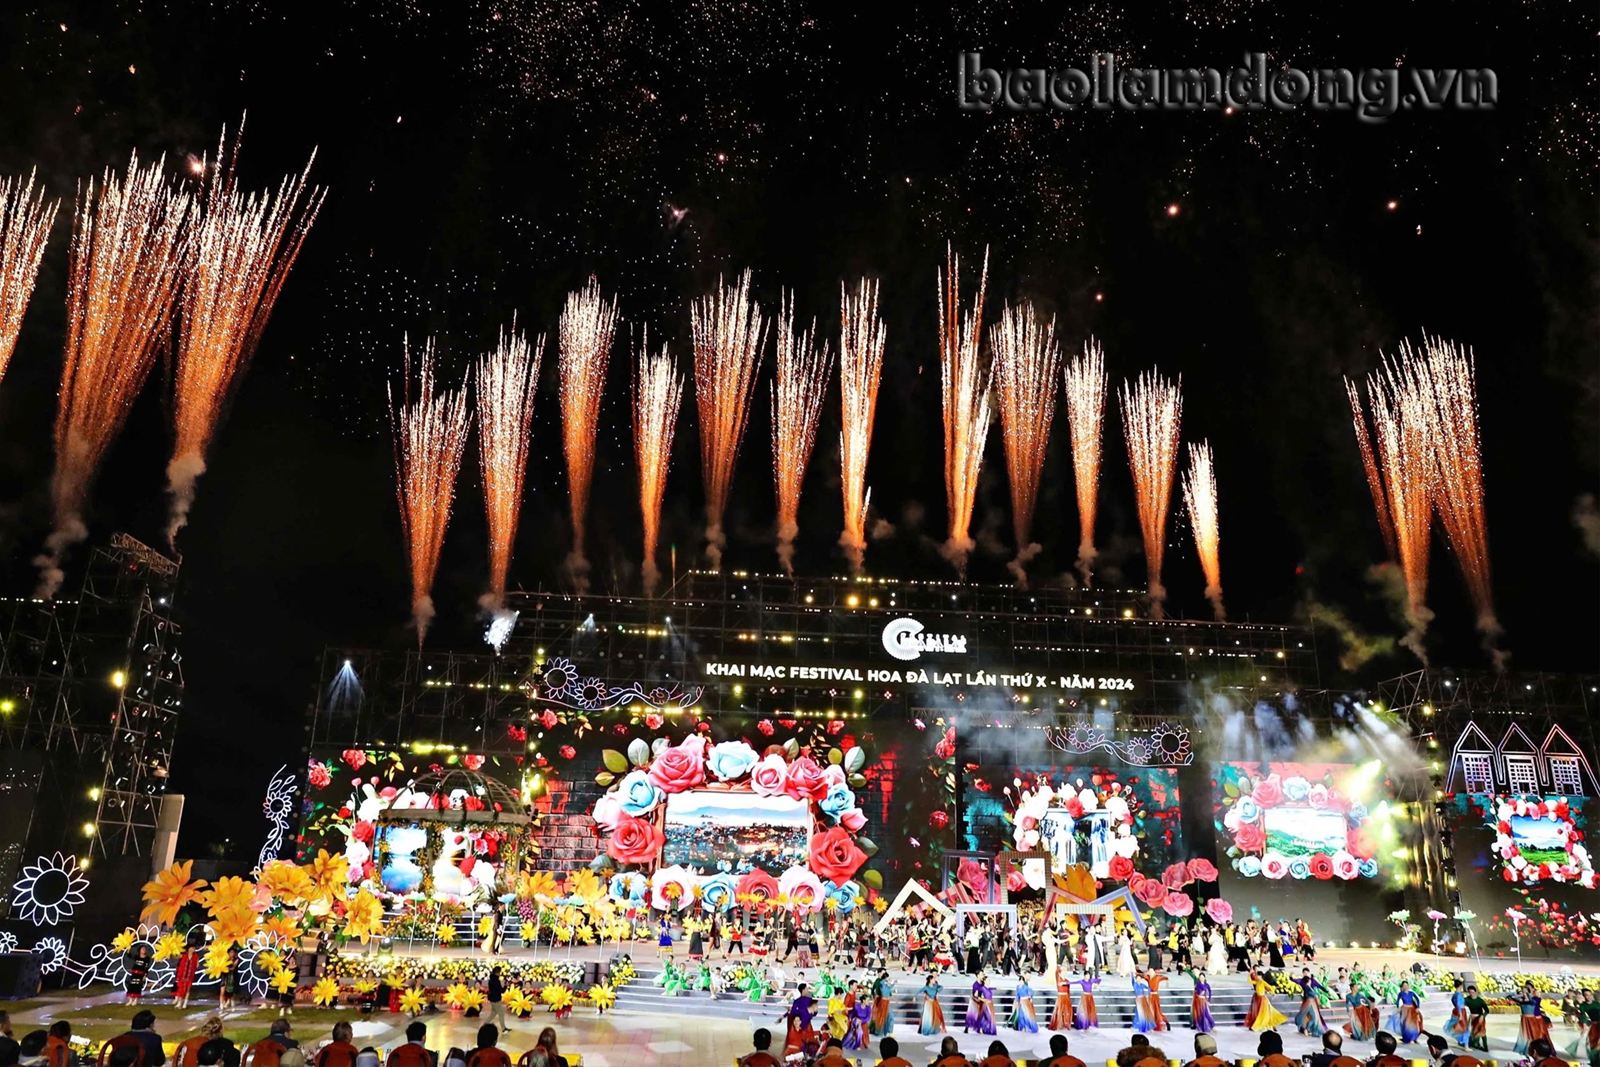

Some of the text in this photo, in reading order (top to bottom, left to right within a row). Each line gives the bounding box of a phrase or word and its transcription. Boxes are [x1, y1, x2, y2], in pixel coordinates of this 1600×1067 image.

[706, 662, 745, 676] KHAI
[750, 664, 785, 681] MẠC
[790, 666, 863, 682] FESTIVAL
[868, 669, 902, 682] HOA
[906, 669, 930, 684] ĐÀ
[933, 672, 963, 687] LẠT
[1000, 672, 1033, 687] THỨ
[1036, 675, 1047, 687] X
[1060, 673, 1095, 690] NĂM
[1098, 677, 1135, 691] 2024
